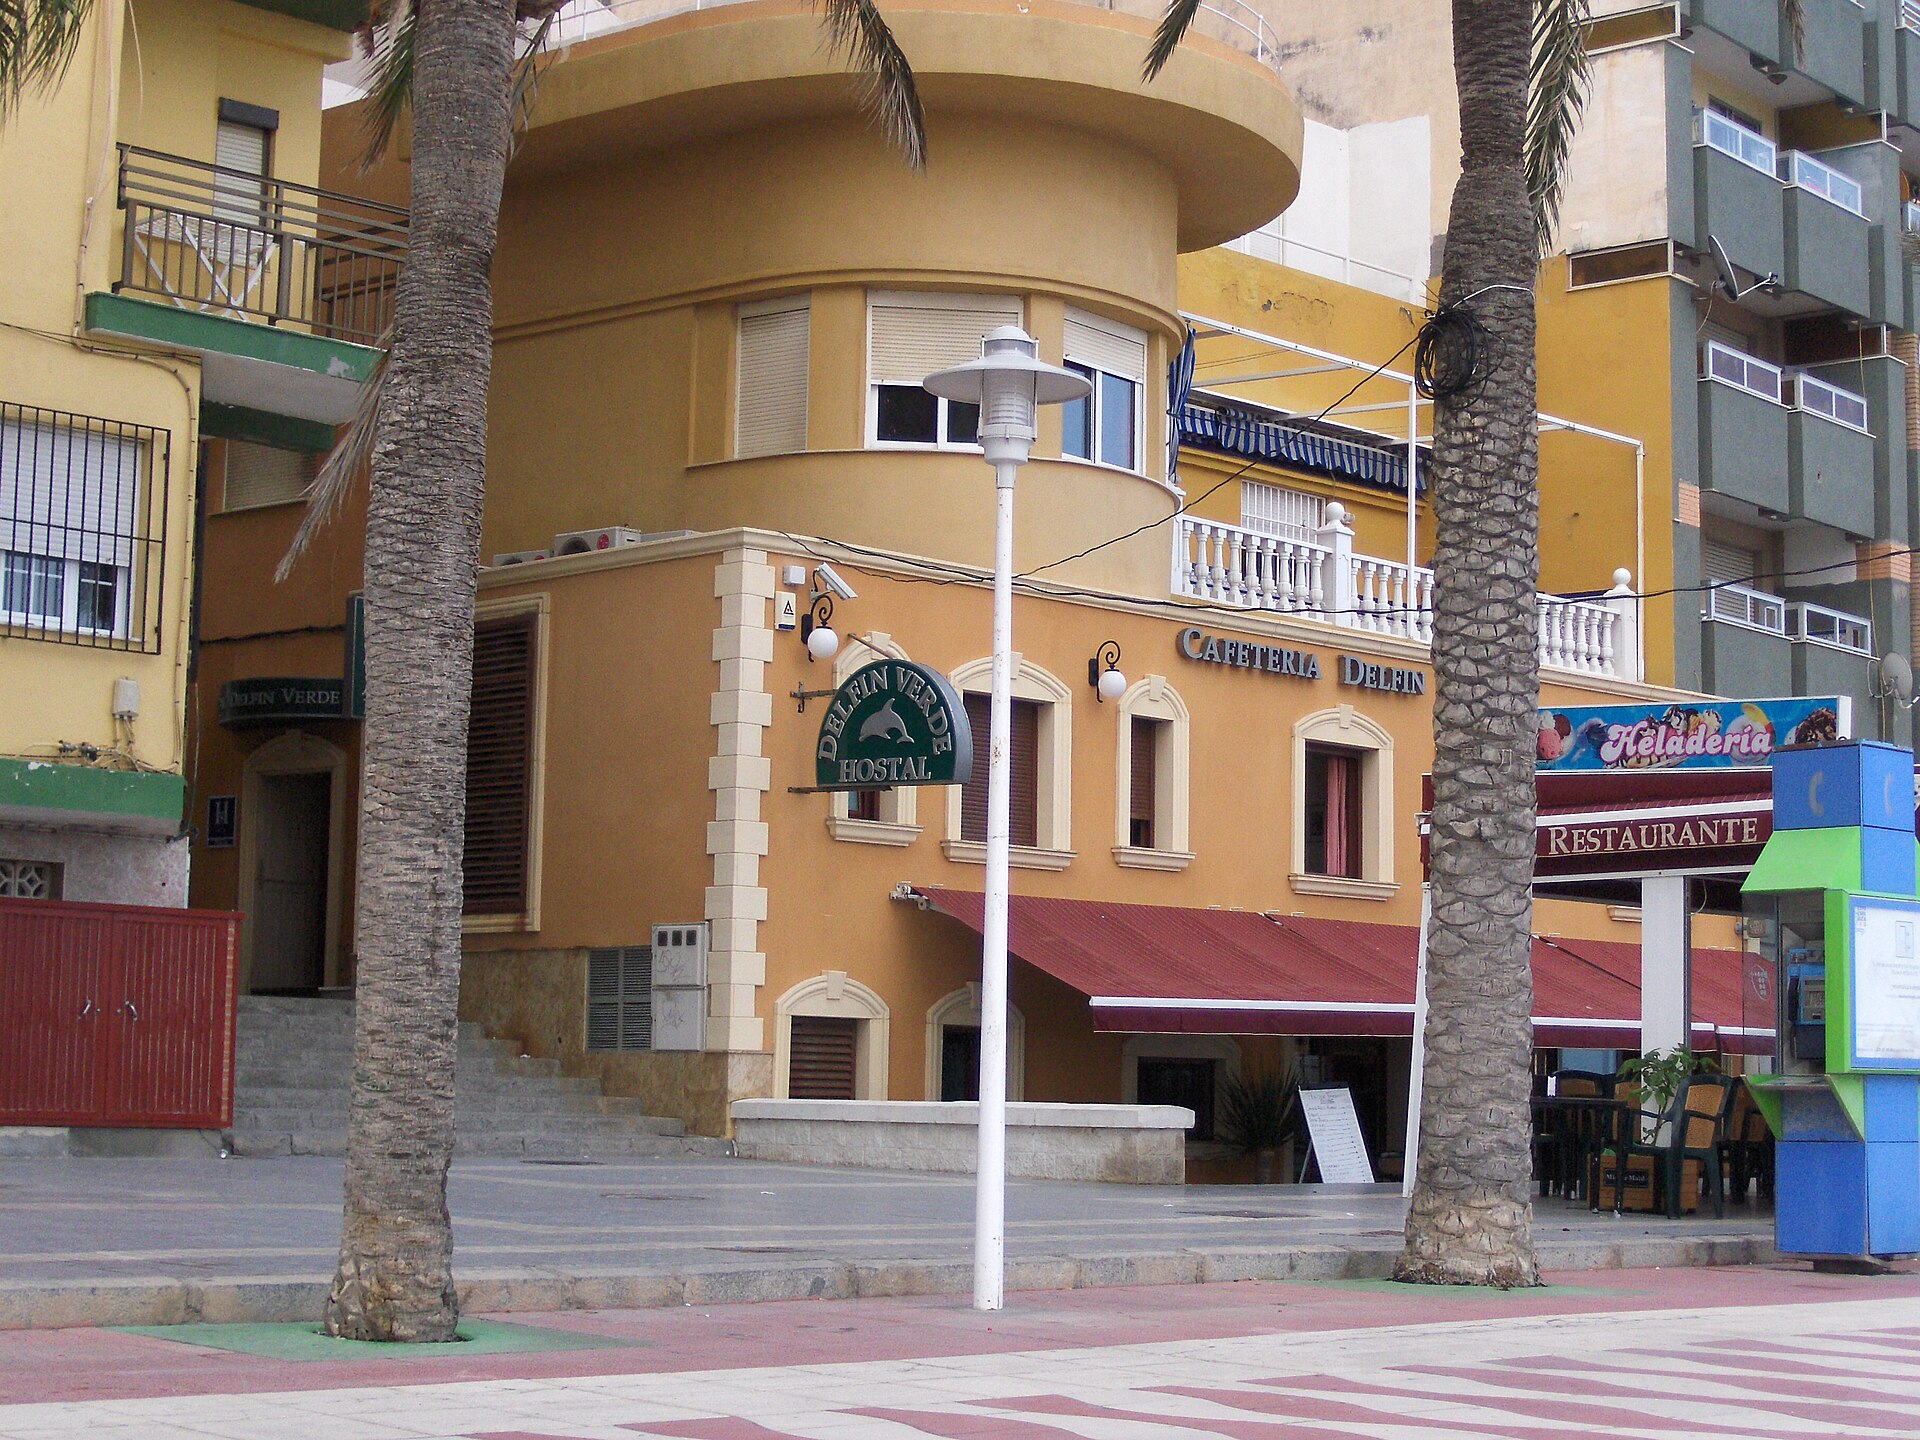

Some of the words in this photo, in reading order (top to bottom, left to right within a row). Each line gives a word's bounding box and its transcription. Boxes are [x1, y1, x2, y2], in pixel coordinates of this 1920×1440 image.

[1178, 627, 1322, 680] CAFETERIA
[1339, 655, 1427, 696] DELFIN
[280, 687, 341, 705] VERDE
[818, 665, 889, 762] DELFIN
[896, 665, 952, 756] VERDE
[1600, 721, 1774, 763] Heladería
[838, 756, 932, 783] HOSTAL
[1548, 817, 1758, 856] RESTAURANTE
